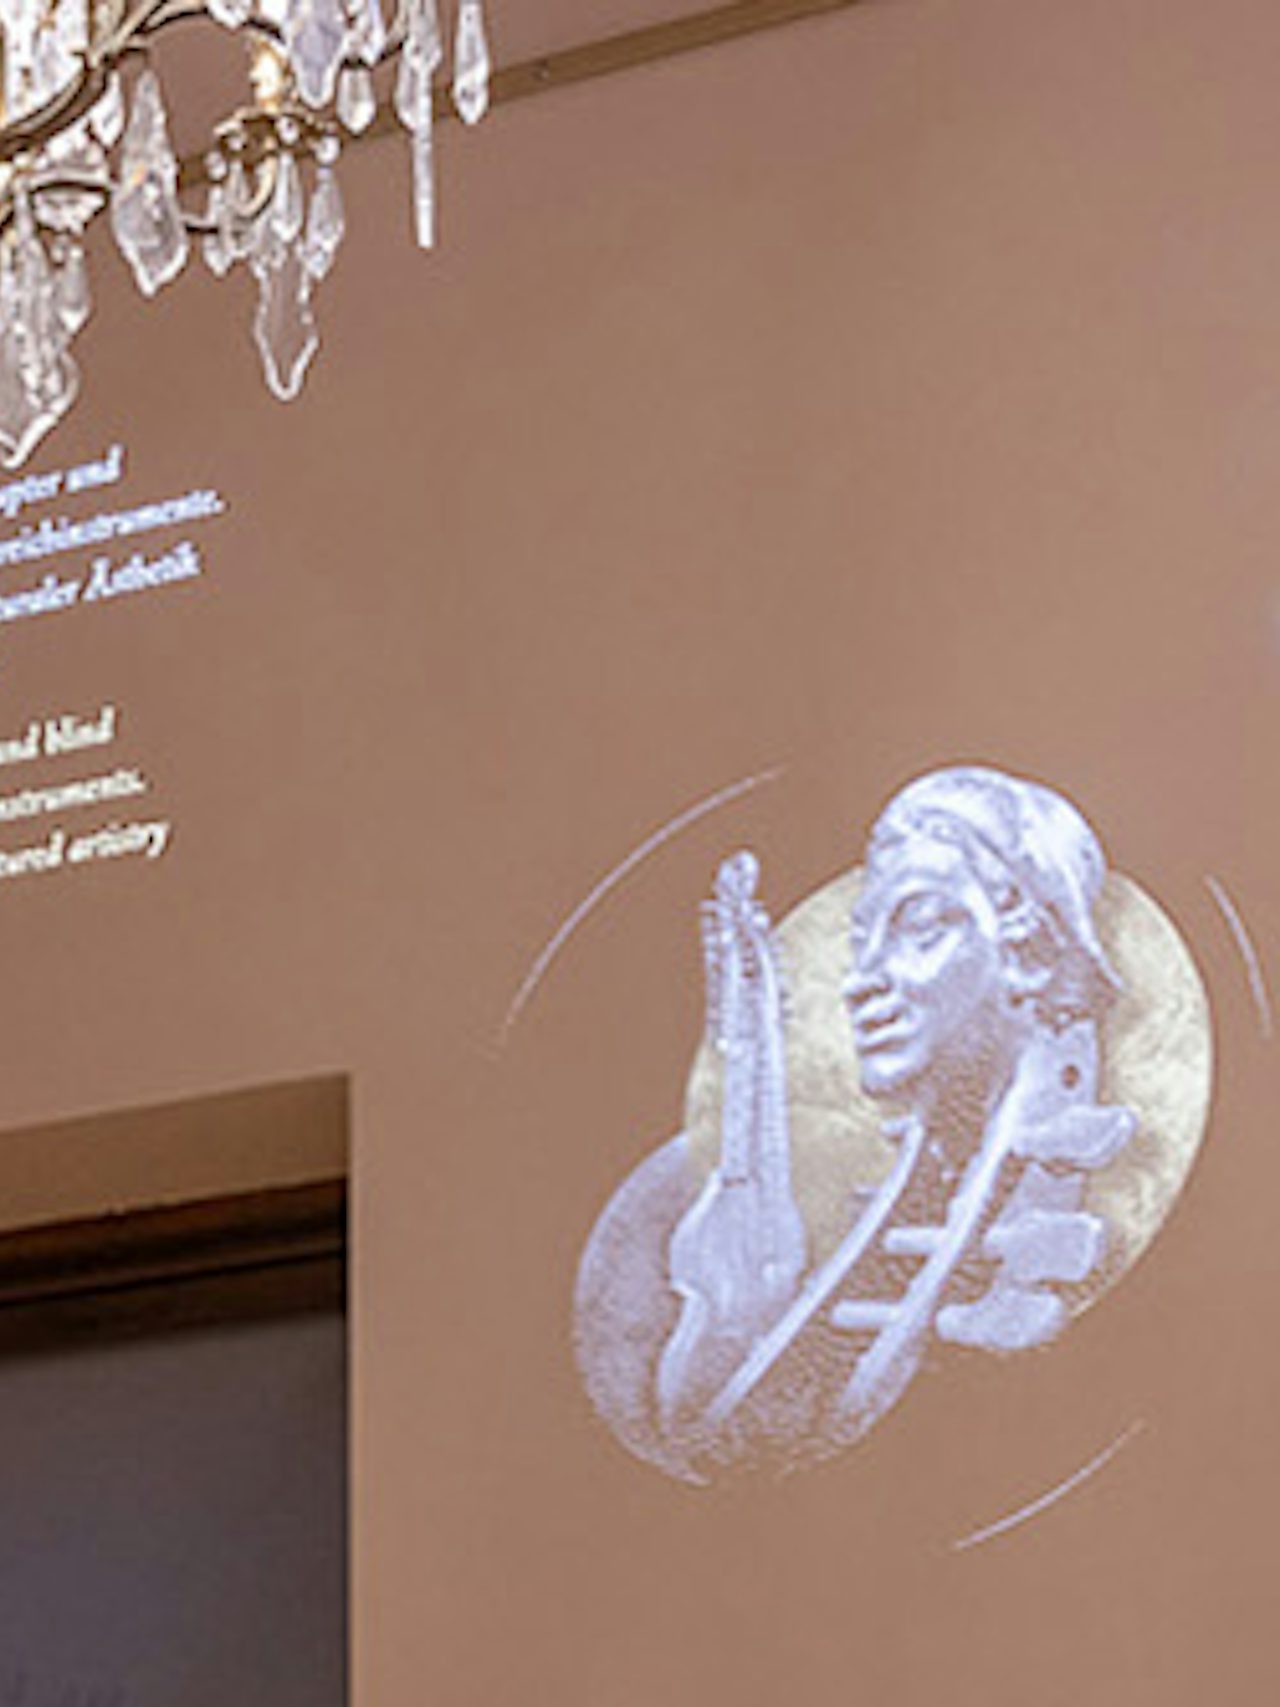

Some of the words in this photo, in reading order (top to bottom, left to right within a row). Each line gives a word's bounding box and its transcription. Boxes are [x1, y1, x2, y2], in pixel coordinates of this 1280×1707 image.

[66, 444, 122, 492] und
[45, 707, 114, 755] blind
[67, 823, 169, 862] artistry
